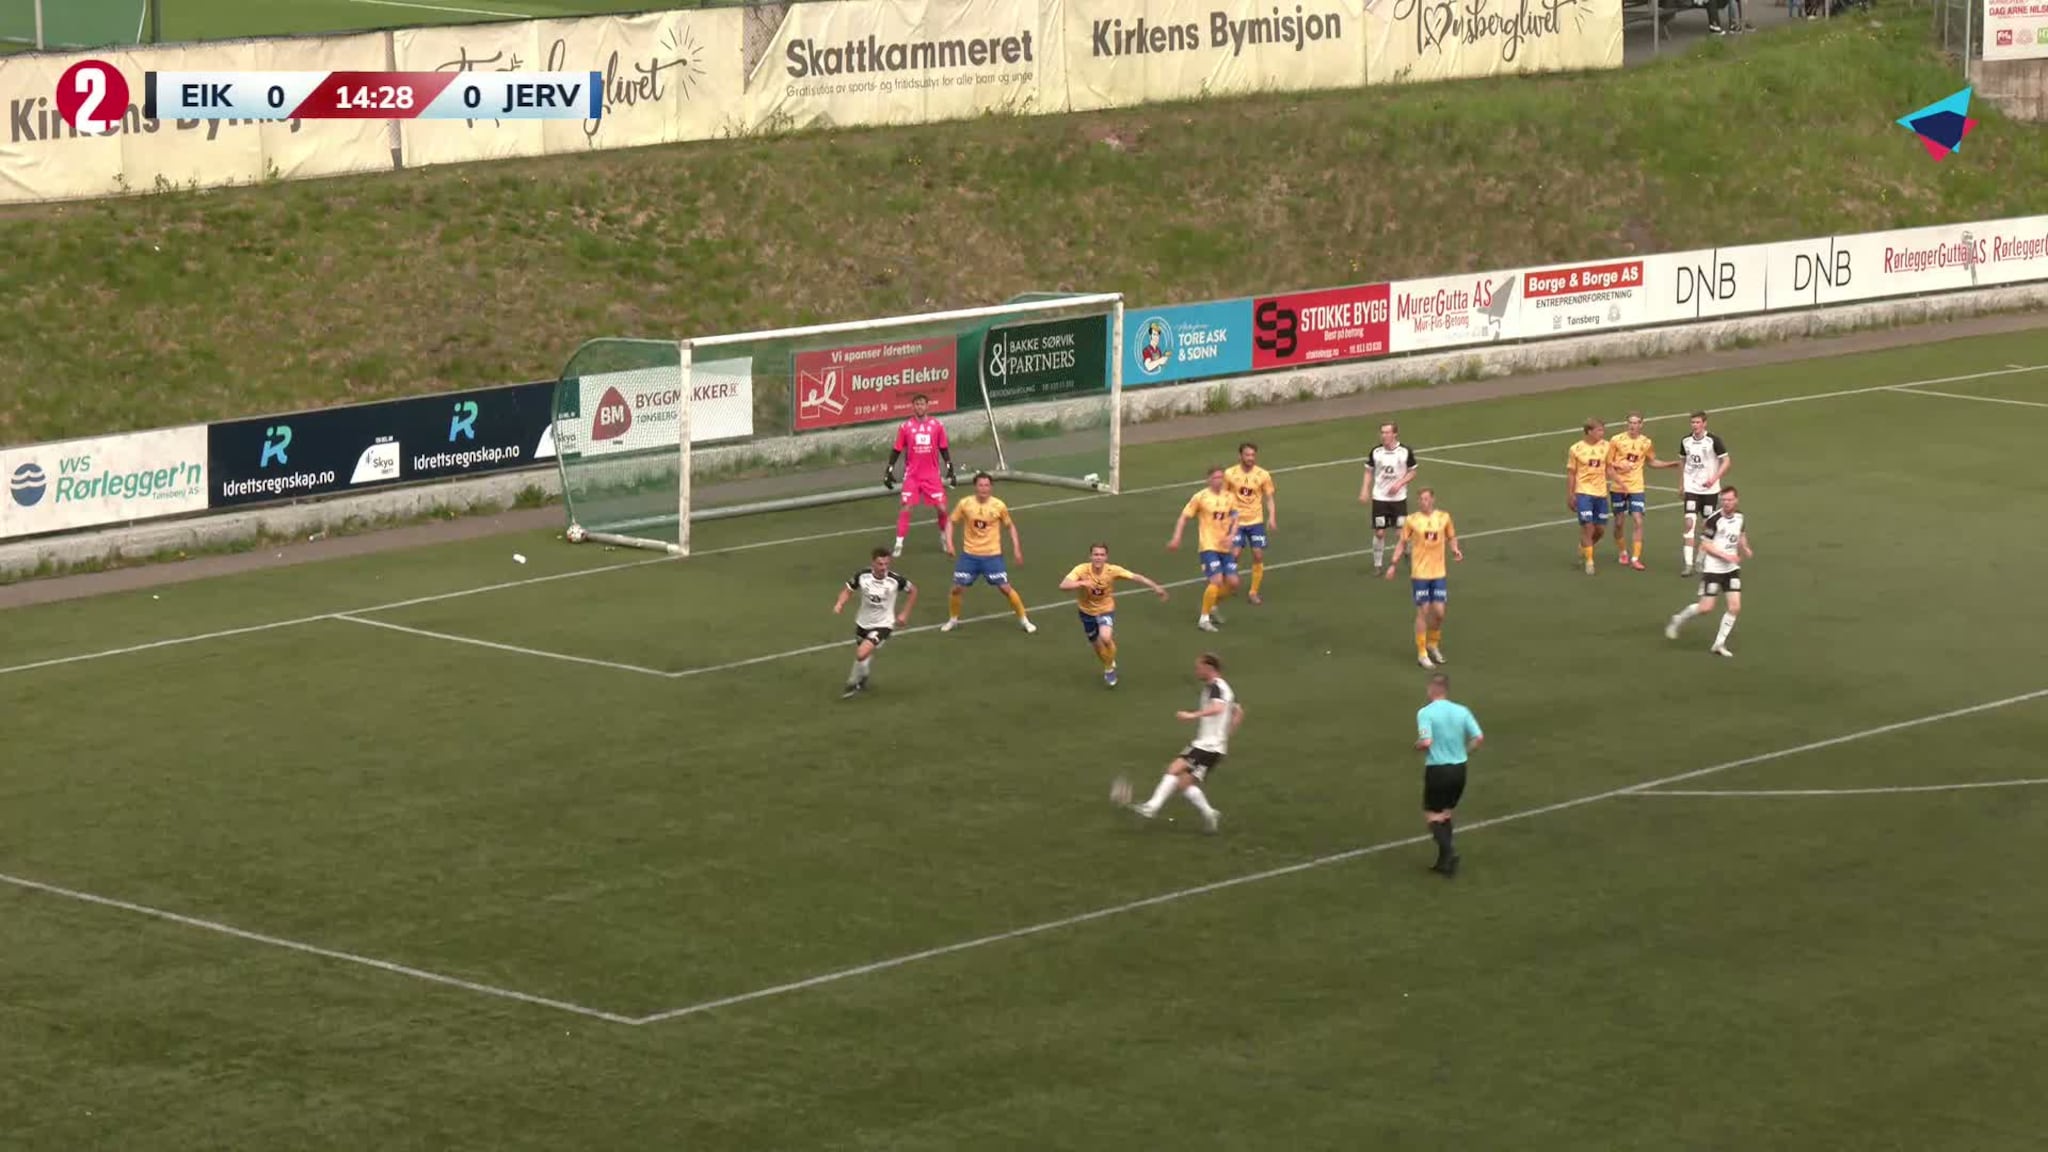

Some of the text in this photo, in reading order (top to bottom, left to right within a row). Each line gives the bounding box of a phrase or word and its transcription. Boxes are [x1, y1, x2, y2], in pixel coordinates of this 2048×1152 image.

[1093, 5, 1341, 56] Kirkens Bymisjon
[786, 30, 1033, 78] Skattkammeret
[786, 84, 815, 97] Gratis
[880, 80, 892, 93] og
[956, 74, 972, 85] alle
[998, 74, 1009, 85] og
[1884, 239, 1987, 273] RørleggerGutta AS
[1993, 236, 2048, 263] Rørlegger
[1528, 267, 1639, 293] Borge & Borge AS
[1676, 248, 1736, 317] DNB
[1794, 236, 1852, 304] DNB
[1397, 279, 1493, 321] MurerGutta AS
[1535, 289, 1633, 309] ENTREPRENØRFORRETNING
[1301, 299, 1388, 333] STOKKE BYGG
[1567, 315, 1600, 326] Tønsberg
[1009, 333, 1075, 353] BAKKE SØRVIK
[1178, 328, 1227, 346] TORE ASK
[831, 344, 923, 364] Vi sponser idretten
[990, 343, 1006, 377] &
[1008, 349, 1075, 375] PARTNERS
[1178, 344, 1217, 361] & SØNN
[852, 367, 949, 392] Norges Elektro
[601, 405, 624, 425] BM
[60, 456, 91, 474] VVS
[413, 444, 520, 471] Idrettsregnskap.no
[55, 461, 202, 503] Rørlegger'n
[223, 470, 335, 497] Idrettsregnskap.no
